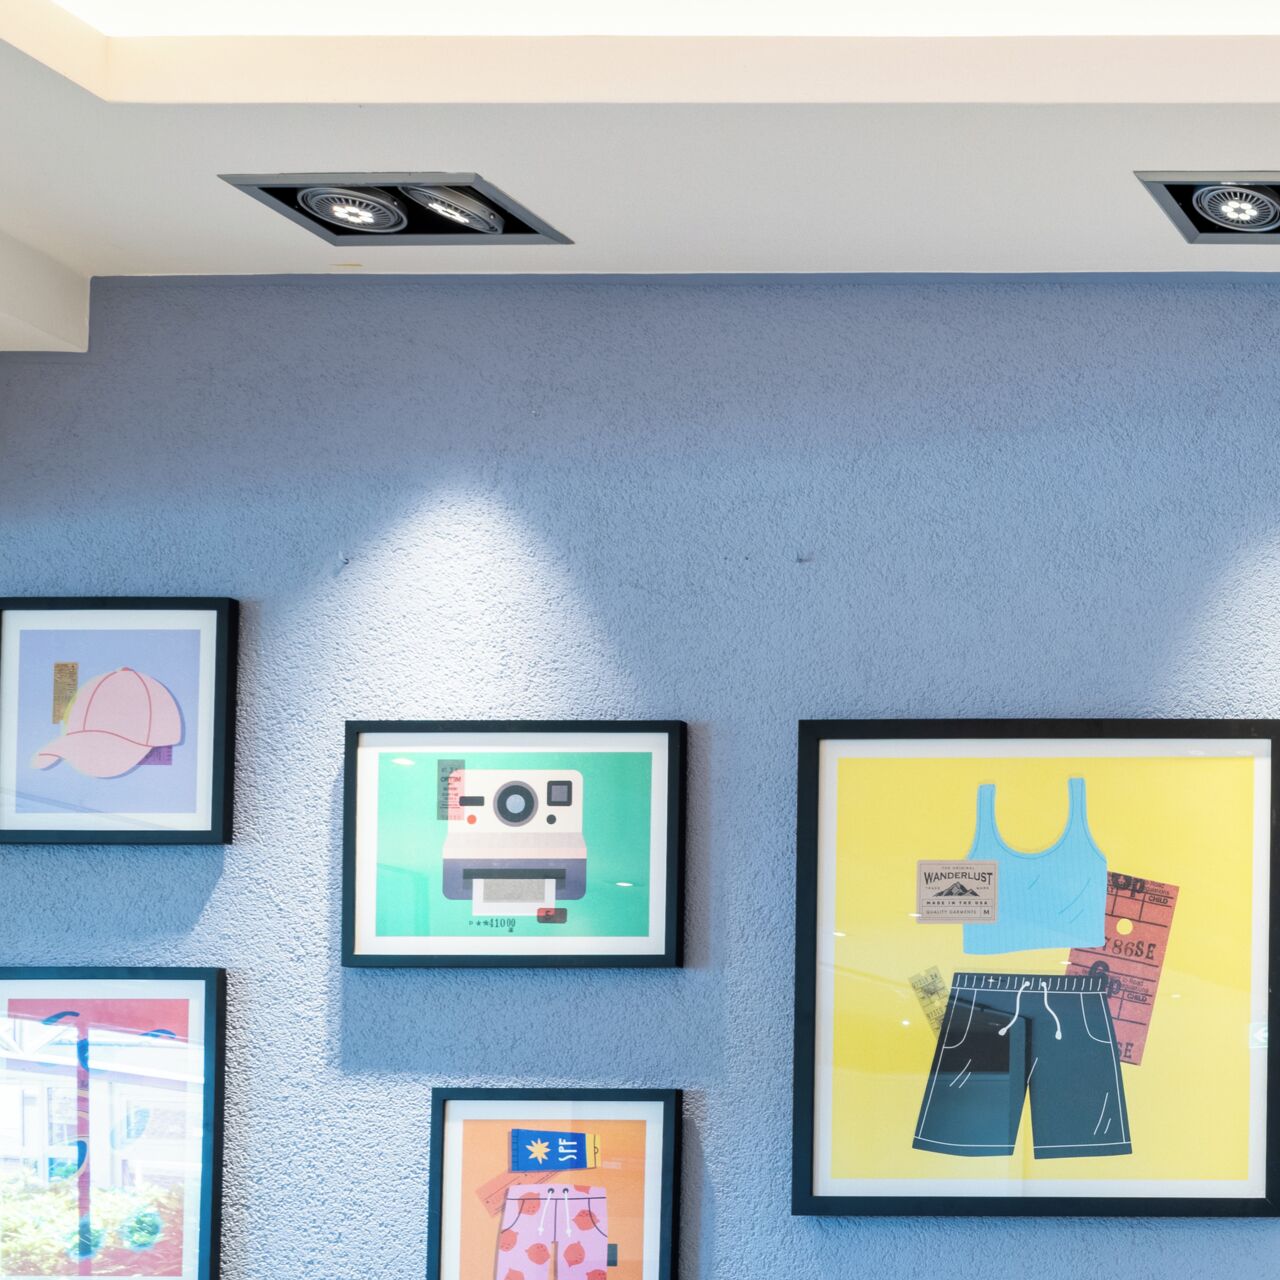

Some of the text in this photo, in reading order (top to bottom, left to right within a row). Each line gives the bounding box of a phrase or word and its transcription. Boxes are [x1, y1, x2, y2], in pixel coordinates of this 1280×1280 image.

[923, 872, 993, 885] WANDERLUST
[1148, 895, 1169, 905] CHILD
[558, 1138, 577, 1162] SPF
